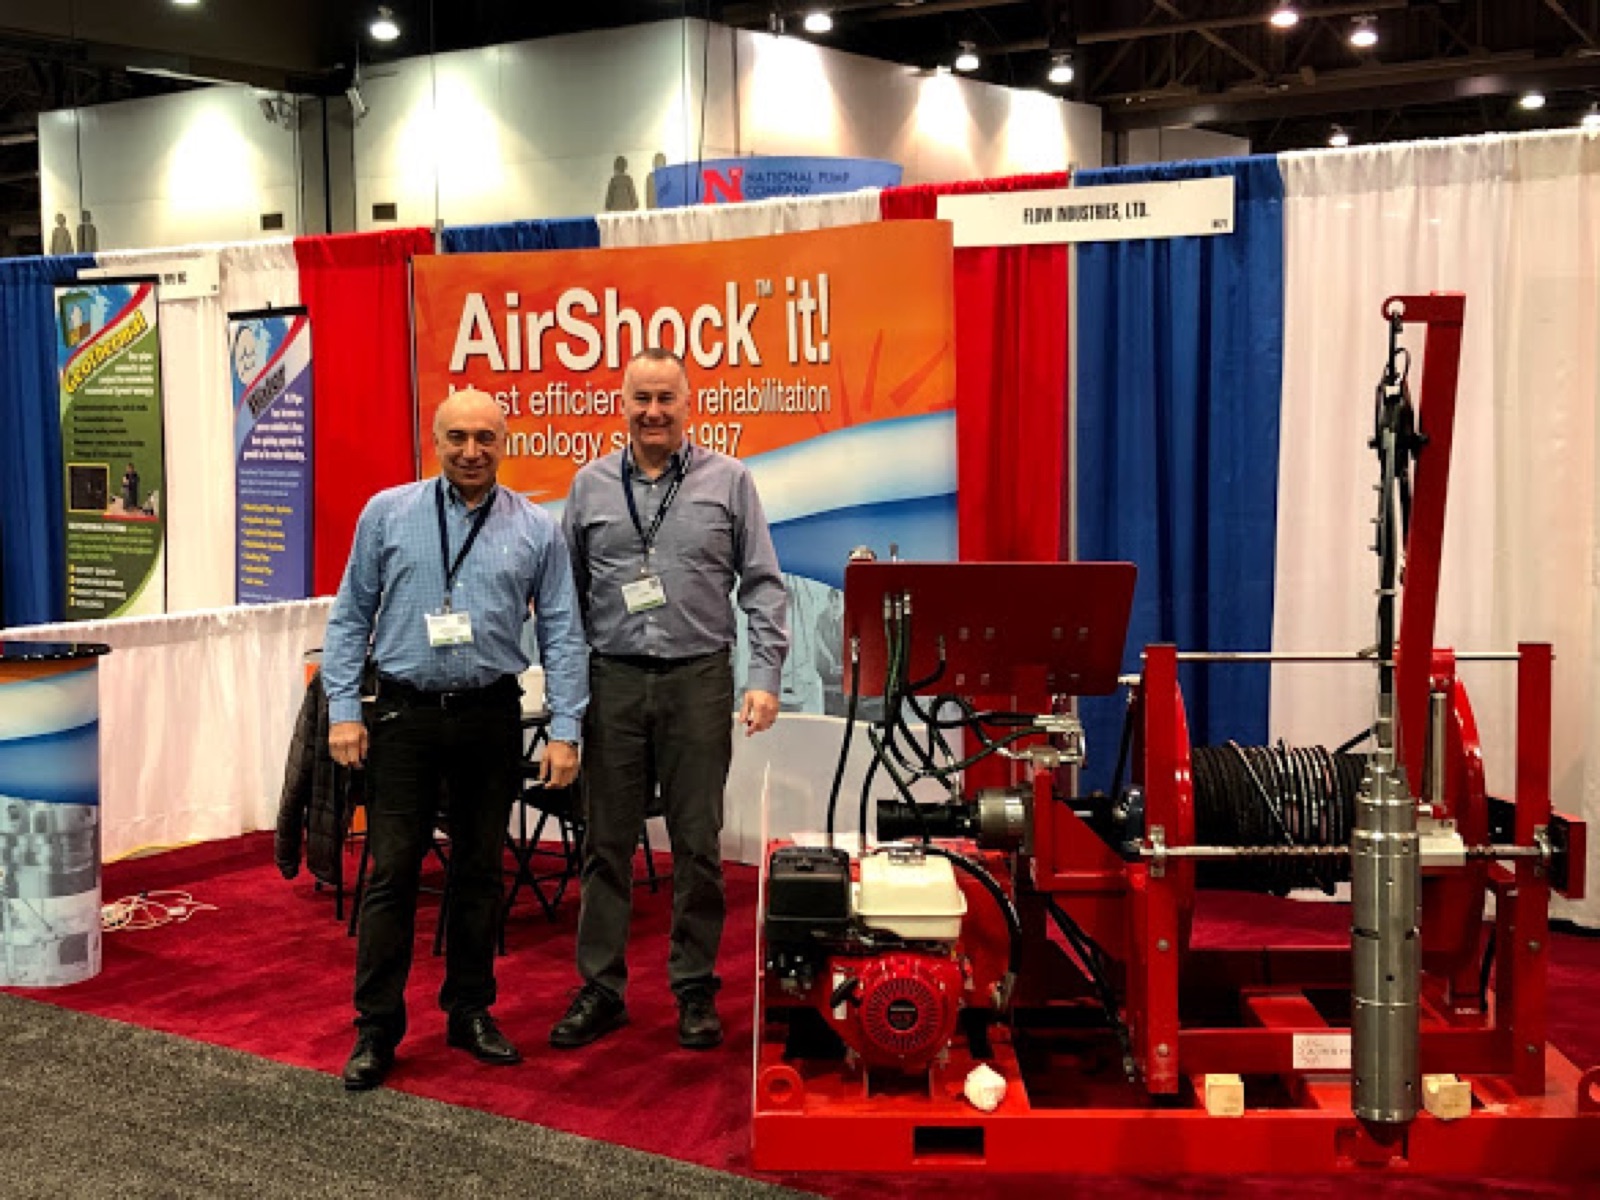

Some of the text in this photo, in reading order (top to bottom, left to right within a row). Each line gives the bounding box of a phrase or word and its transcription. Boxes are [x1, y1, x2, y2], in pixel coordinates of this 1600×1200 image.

[702, 167, 743, 205] N
[745, 185, 810, 198] COMPANY
[746, 170, 850, 185] NATIONAL PUMP
[1023, 202, 1150, 224] FLOW INDUSTRIES, LTD.
[786, 273, 831, 365] it!
[697, 379, 831, 413] rehabilitation
[687, 422, 742, 457] 1997
